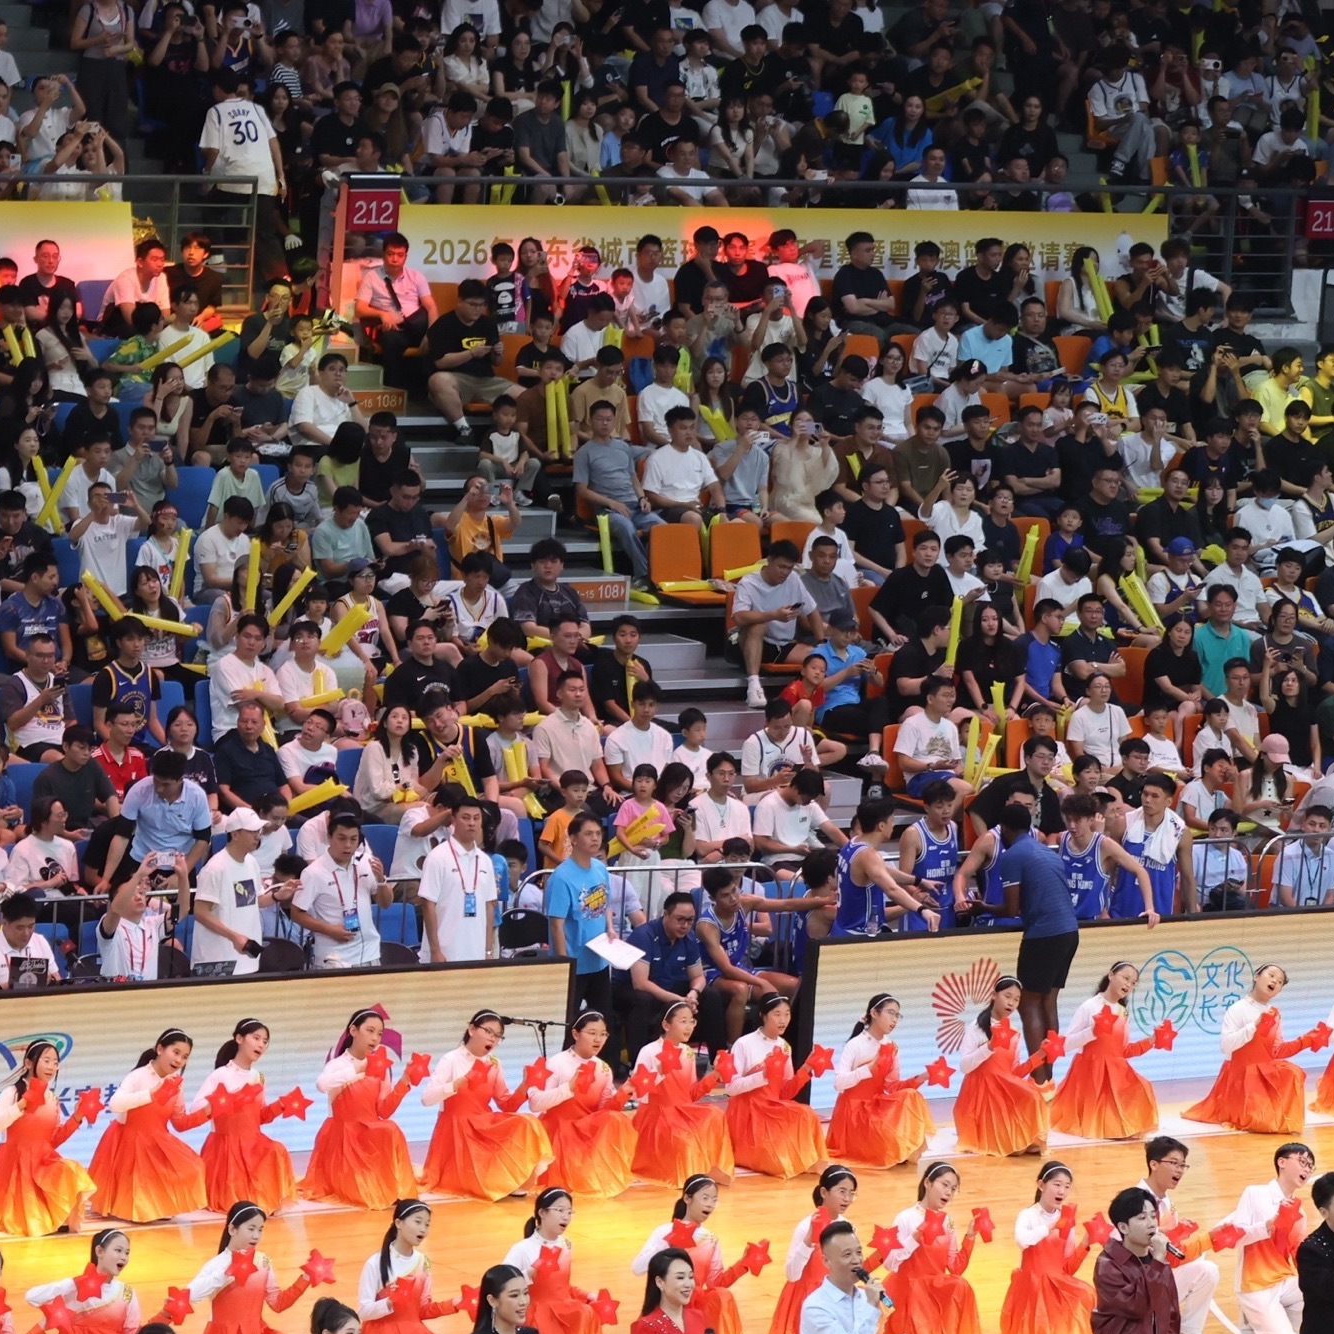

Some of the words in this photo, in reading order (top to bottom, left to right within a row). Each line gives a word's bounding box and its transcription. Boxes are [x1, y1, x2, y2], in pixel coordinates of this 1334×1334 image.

[229, 120, 259, 146] 30
[353, 200, 394, 225] 212
[376, 394, 398, 407] 108
[598, 585, 619, 598] 108
[926, 868, 946, 879] HONG
[1077, 880, 1094, 891] KONG
[1202, 961, 1246, 990] 文化
